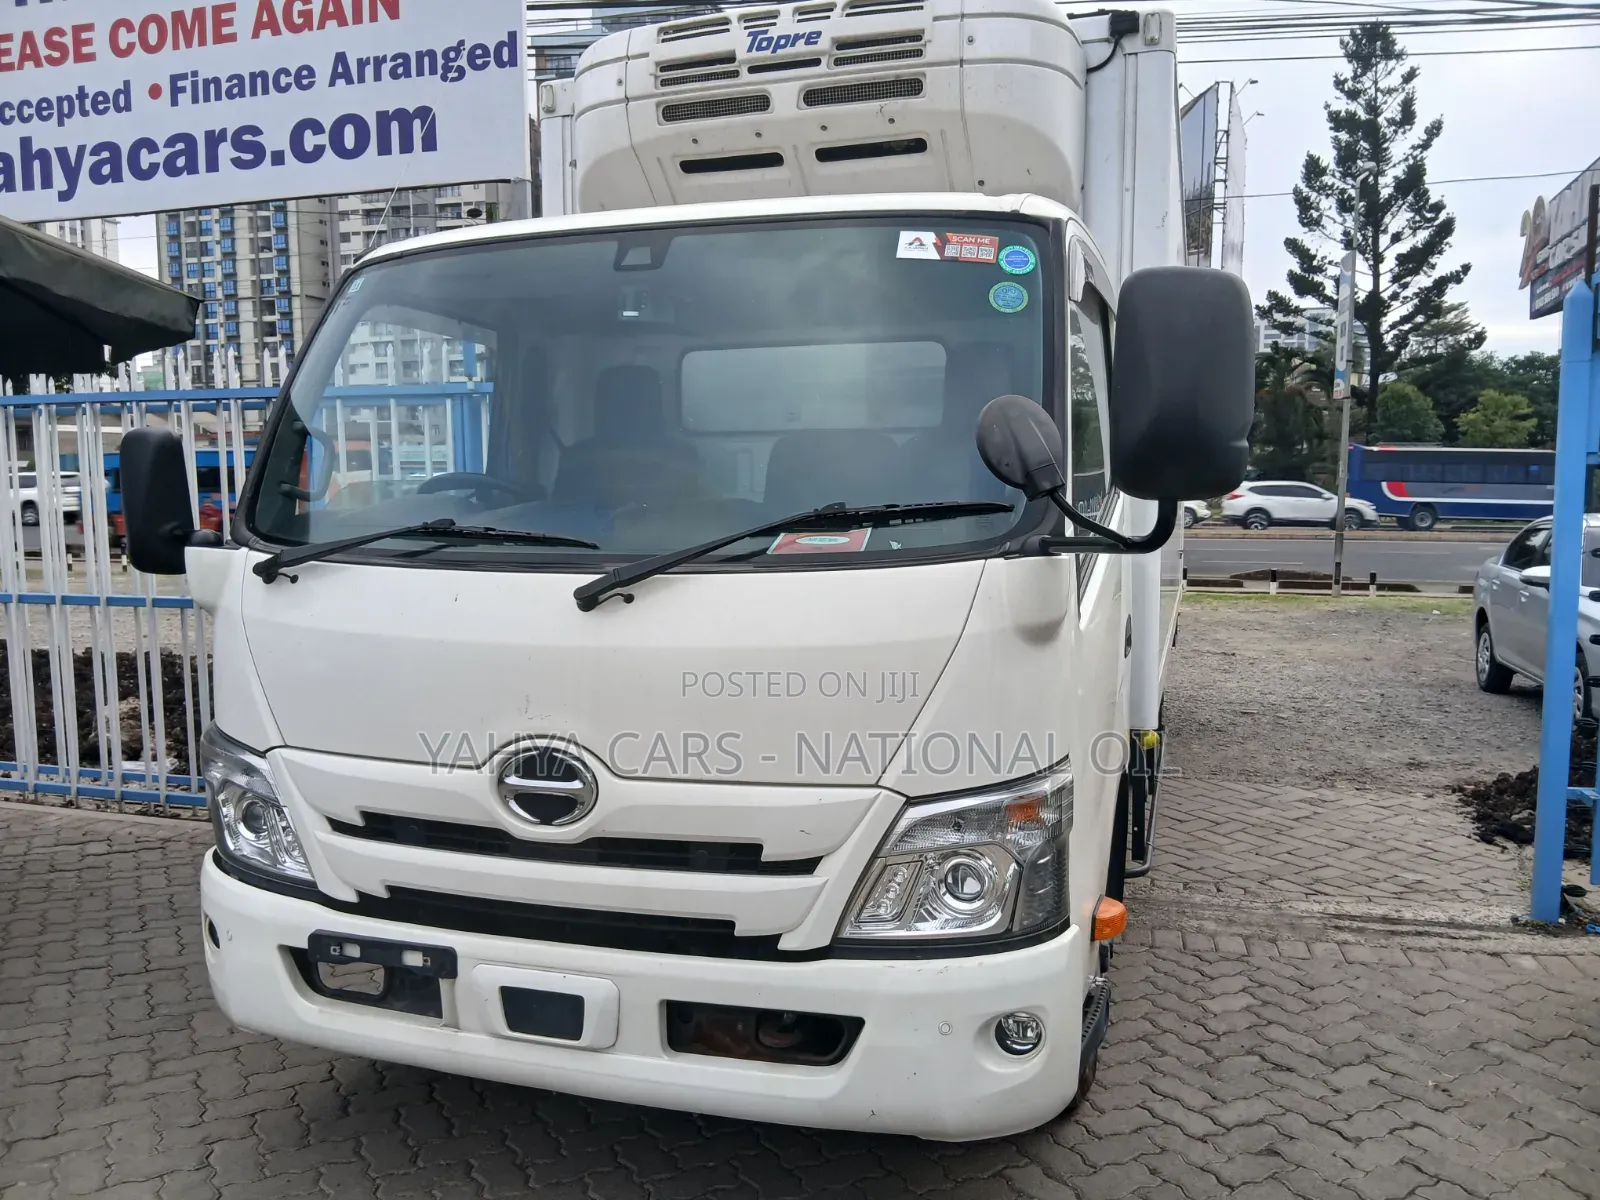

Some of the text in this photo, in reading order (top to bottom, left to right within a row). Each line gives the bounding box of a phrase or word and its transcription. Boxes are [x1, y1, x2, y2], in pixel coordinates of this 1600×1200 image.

[109, 2, 238, 58] COME
[746, 29, 822, 54] Topre
[170, 66, 316, 107] Finance
[328, 30, 518, 88] Arranged
[952, 236, 975, 244] SCAN
